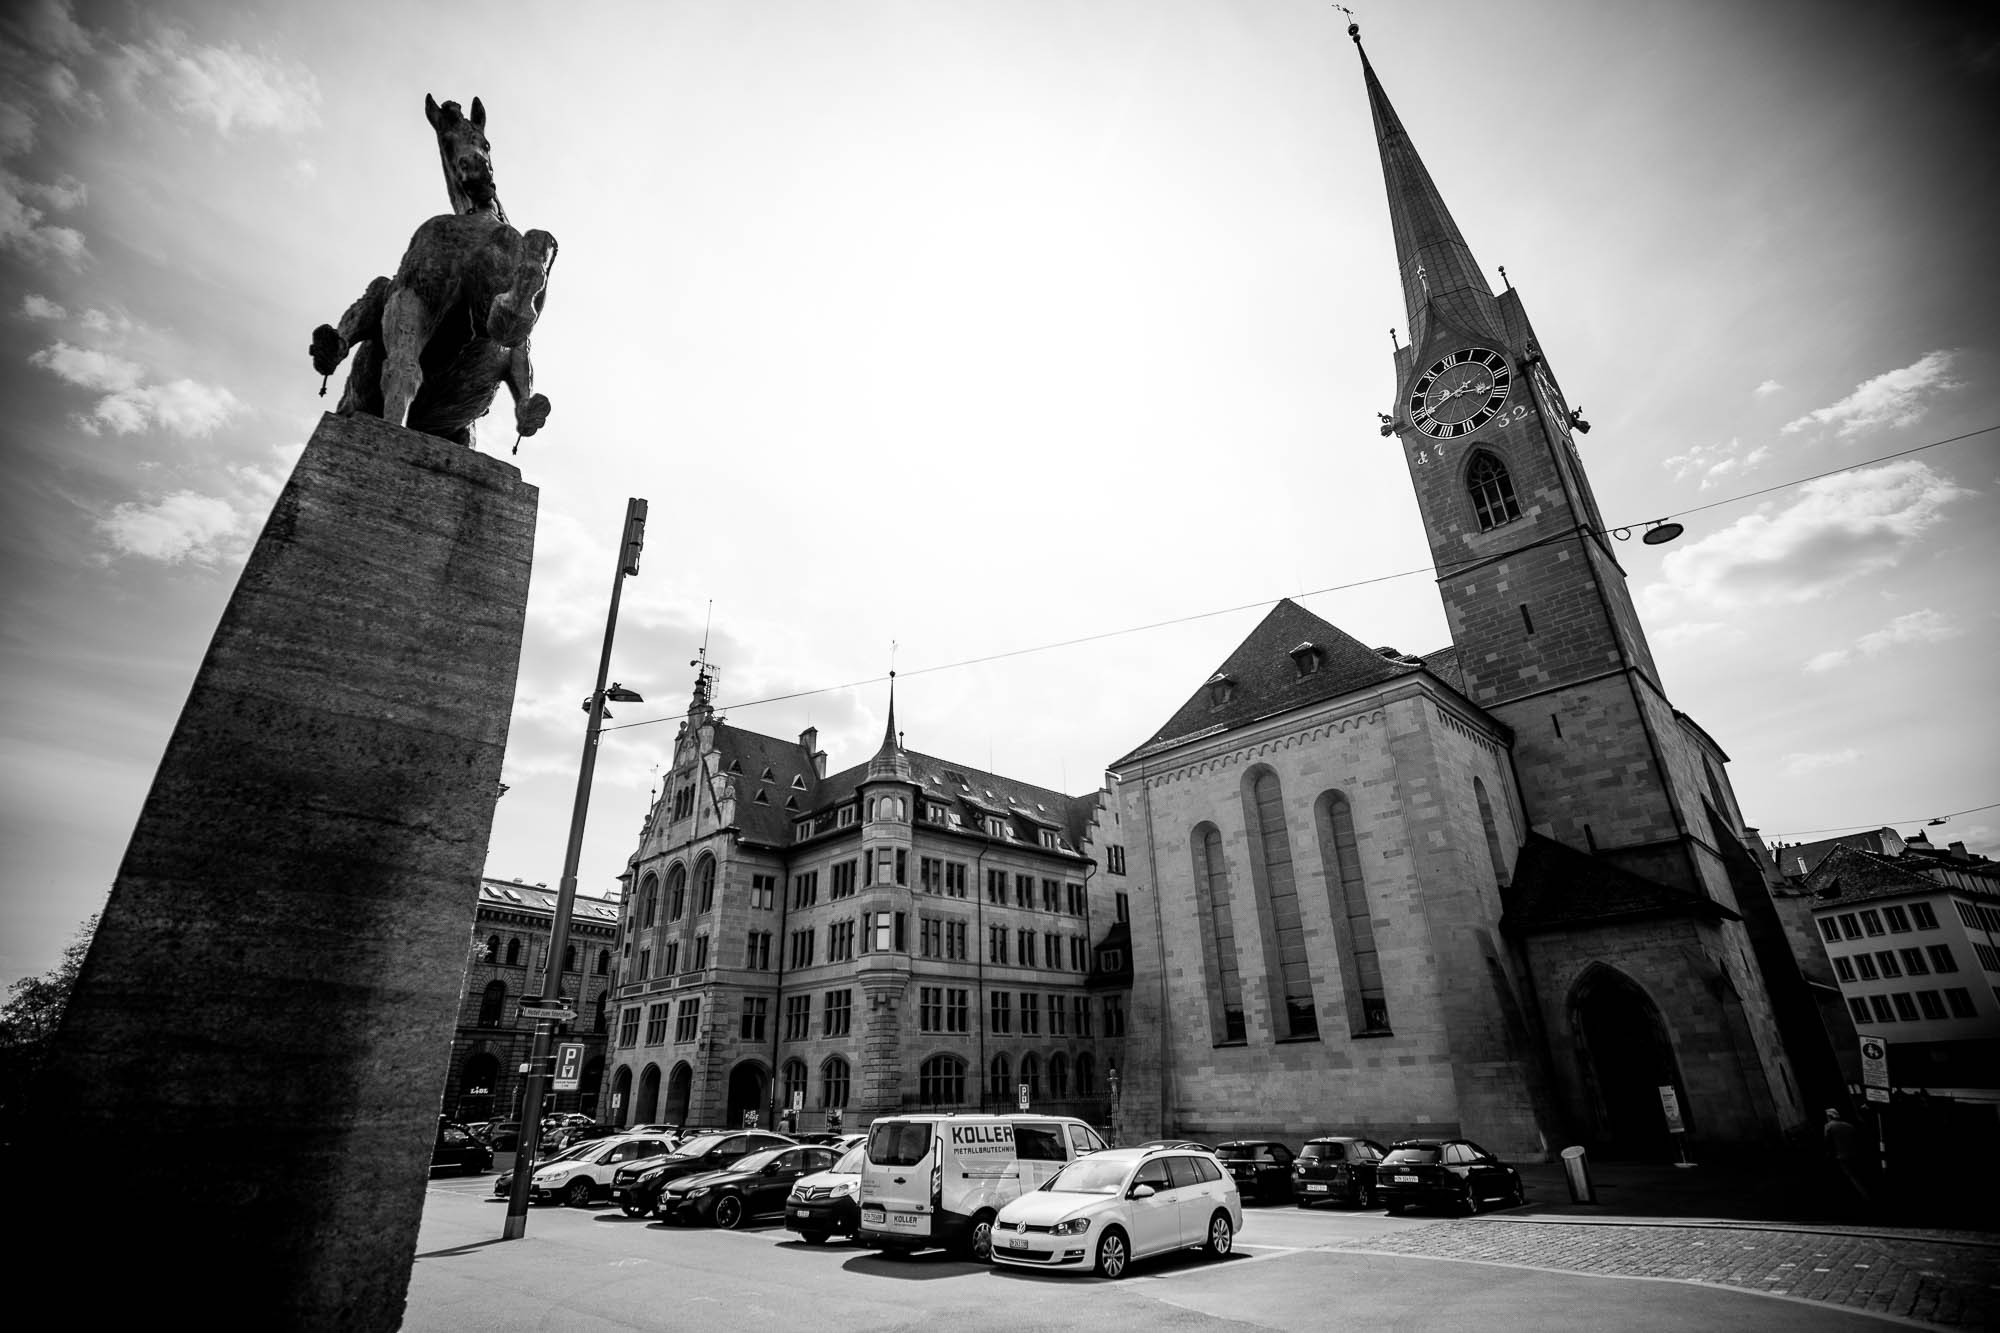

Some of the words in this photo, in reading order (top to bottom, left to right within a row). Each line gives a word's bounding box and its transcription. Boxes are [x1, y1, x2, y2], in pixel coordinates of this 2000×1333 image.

[1441, 354, 1456, 369] XII
[1423, 370, 1438, 382] XI
[564, 1048, 577, 1065] P
[1021, 1087, 1027, 1096] P
[952, 1126, 1014, 1144] KOLLER
[893, 1215, 918, 1224] KOLLER
